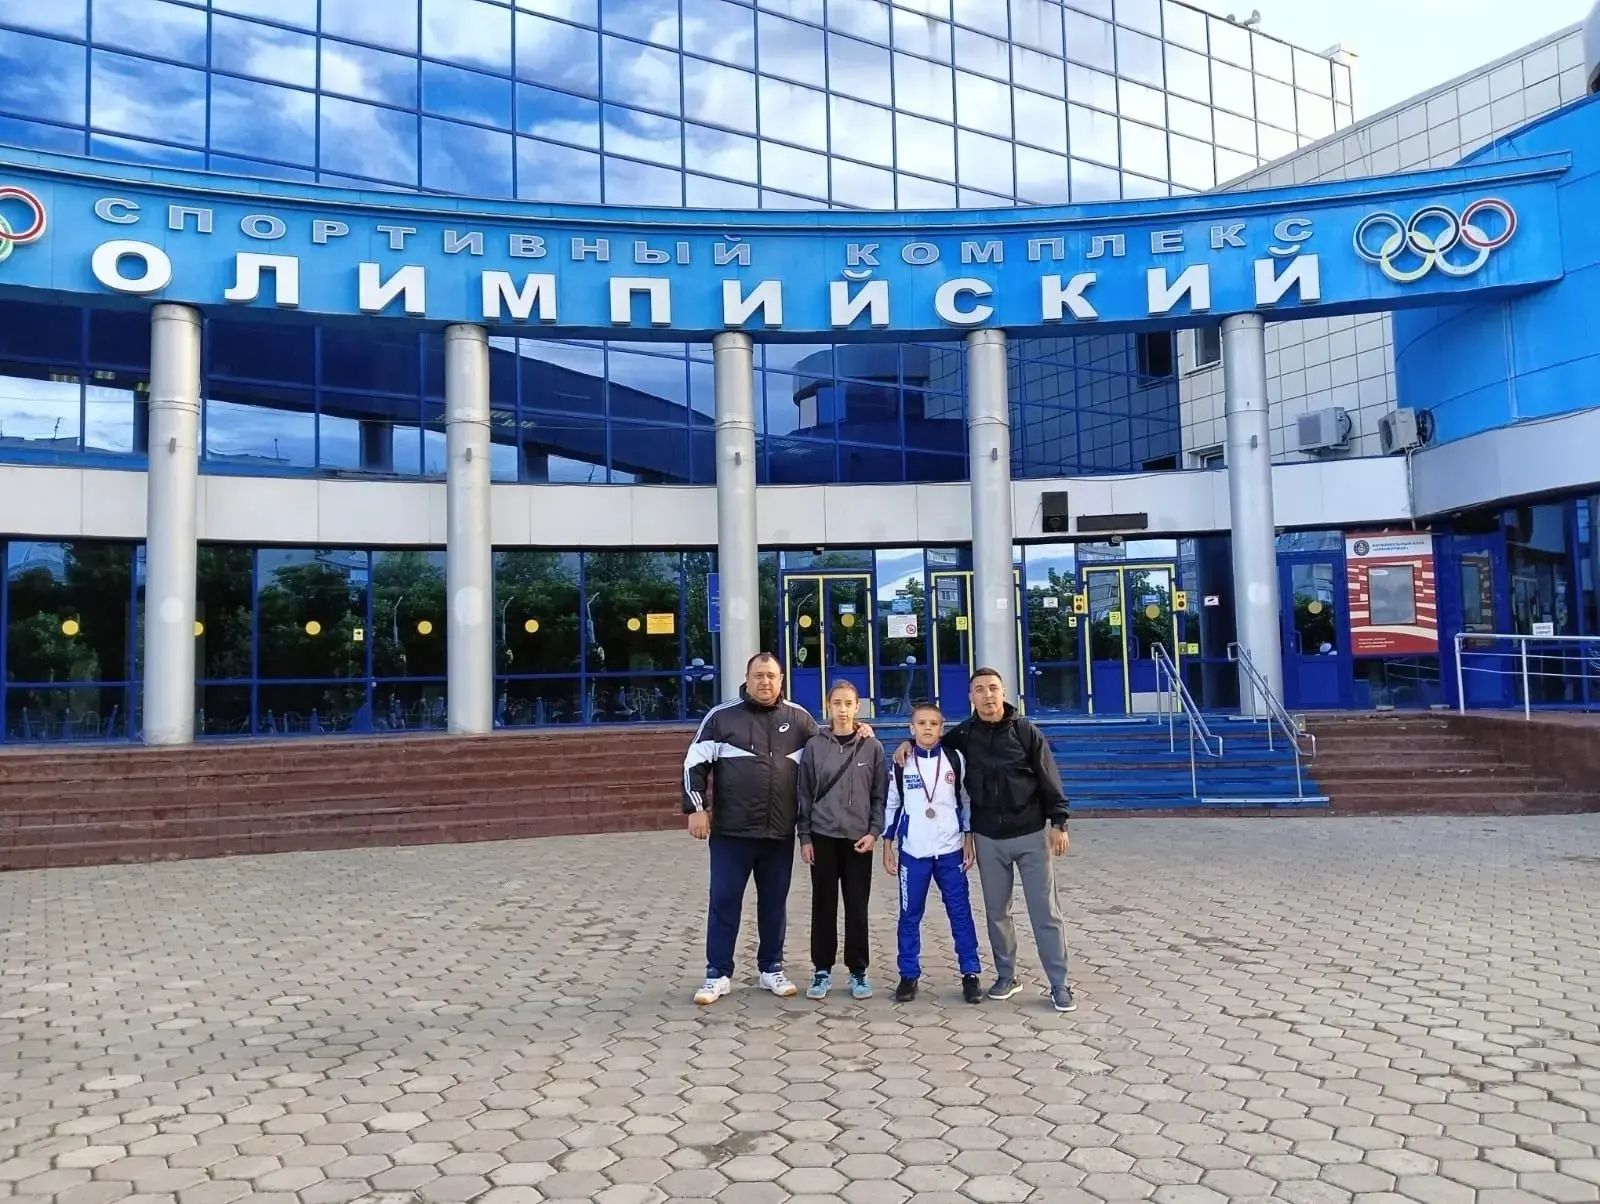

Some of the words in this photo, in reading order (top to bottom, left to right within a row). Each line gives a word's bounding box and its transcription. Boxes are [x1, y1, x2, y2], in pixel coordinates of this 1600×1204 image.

[94, 197, 752, 267] СПОРТИВНЫЙ
[846, 217, 1314, 267] КОМПЛЕКС
[91, 238, 1321, 329] ОЛИМПИЙСКИЙ
